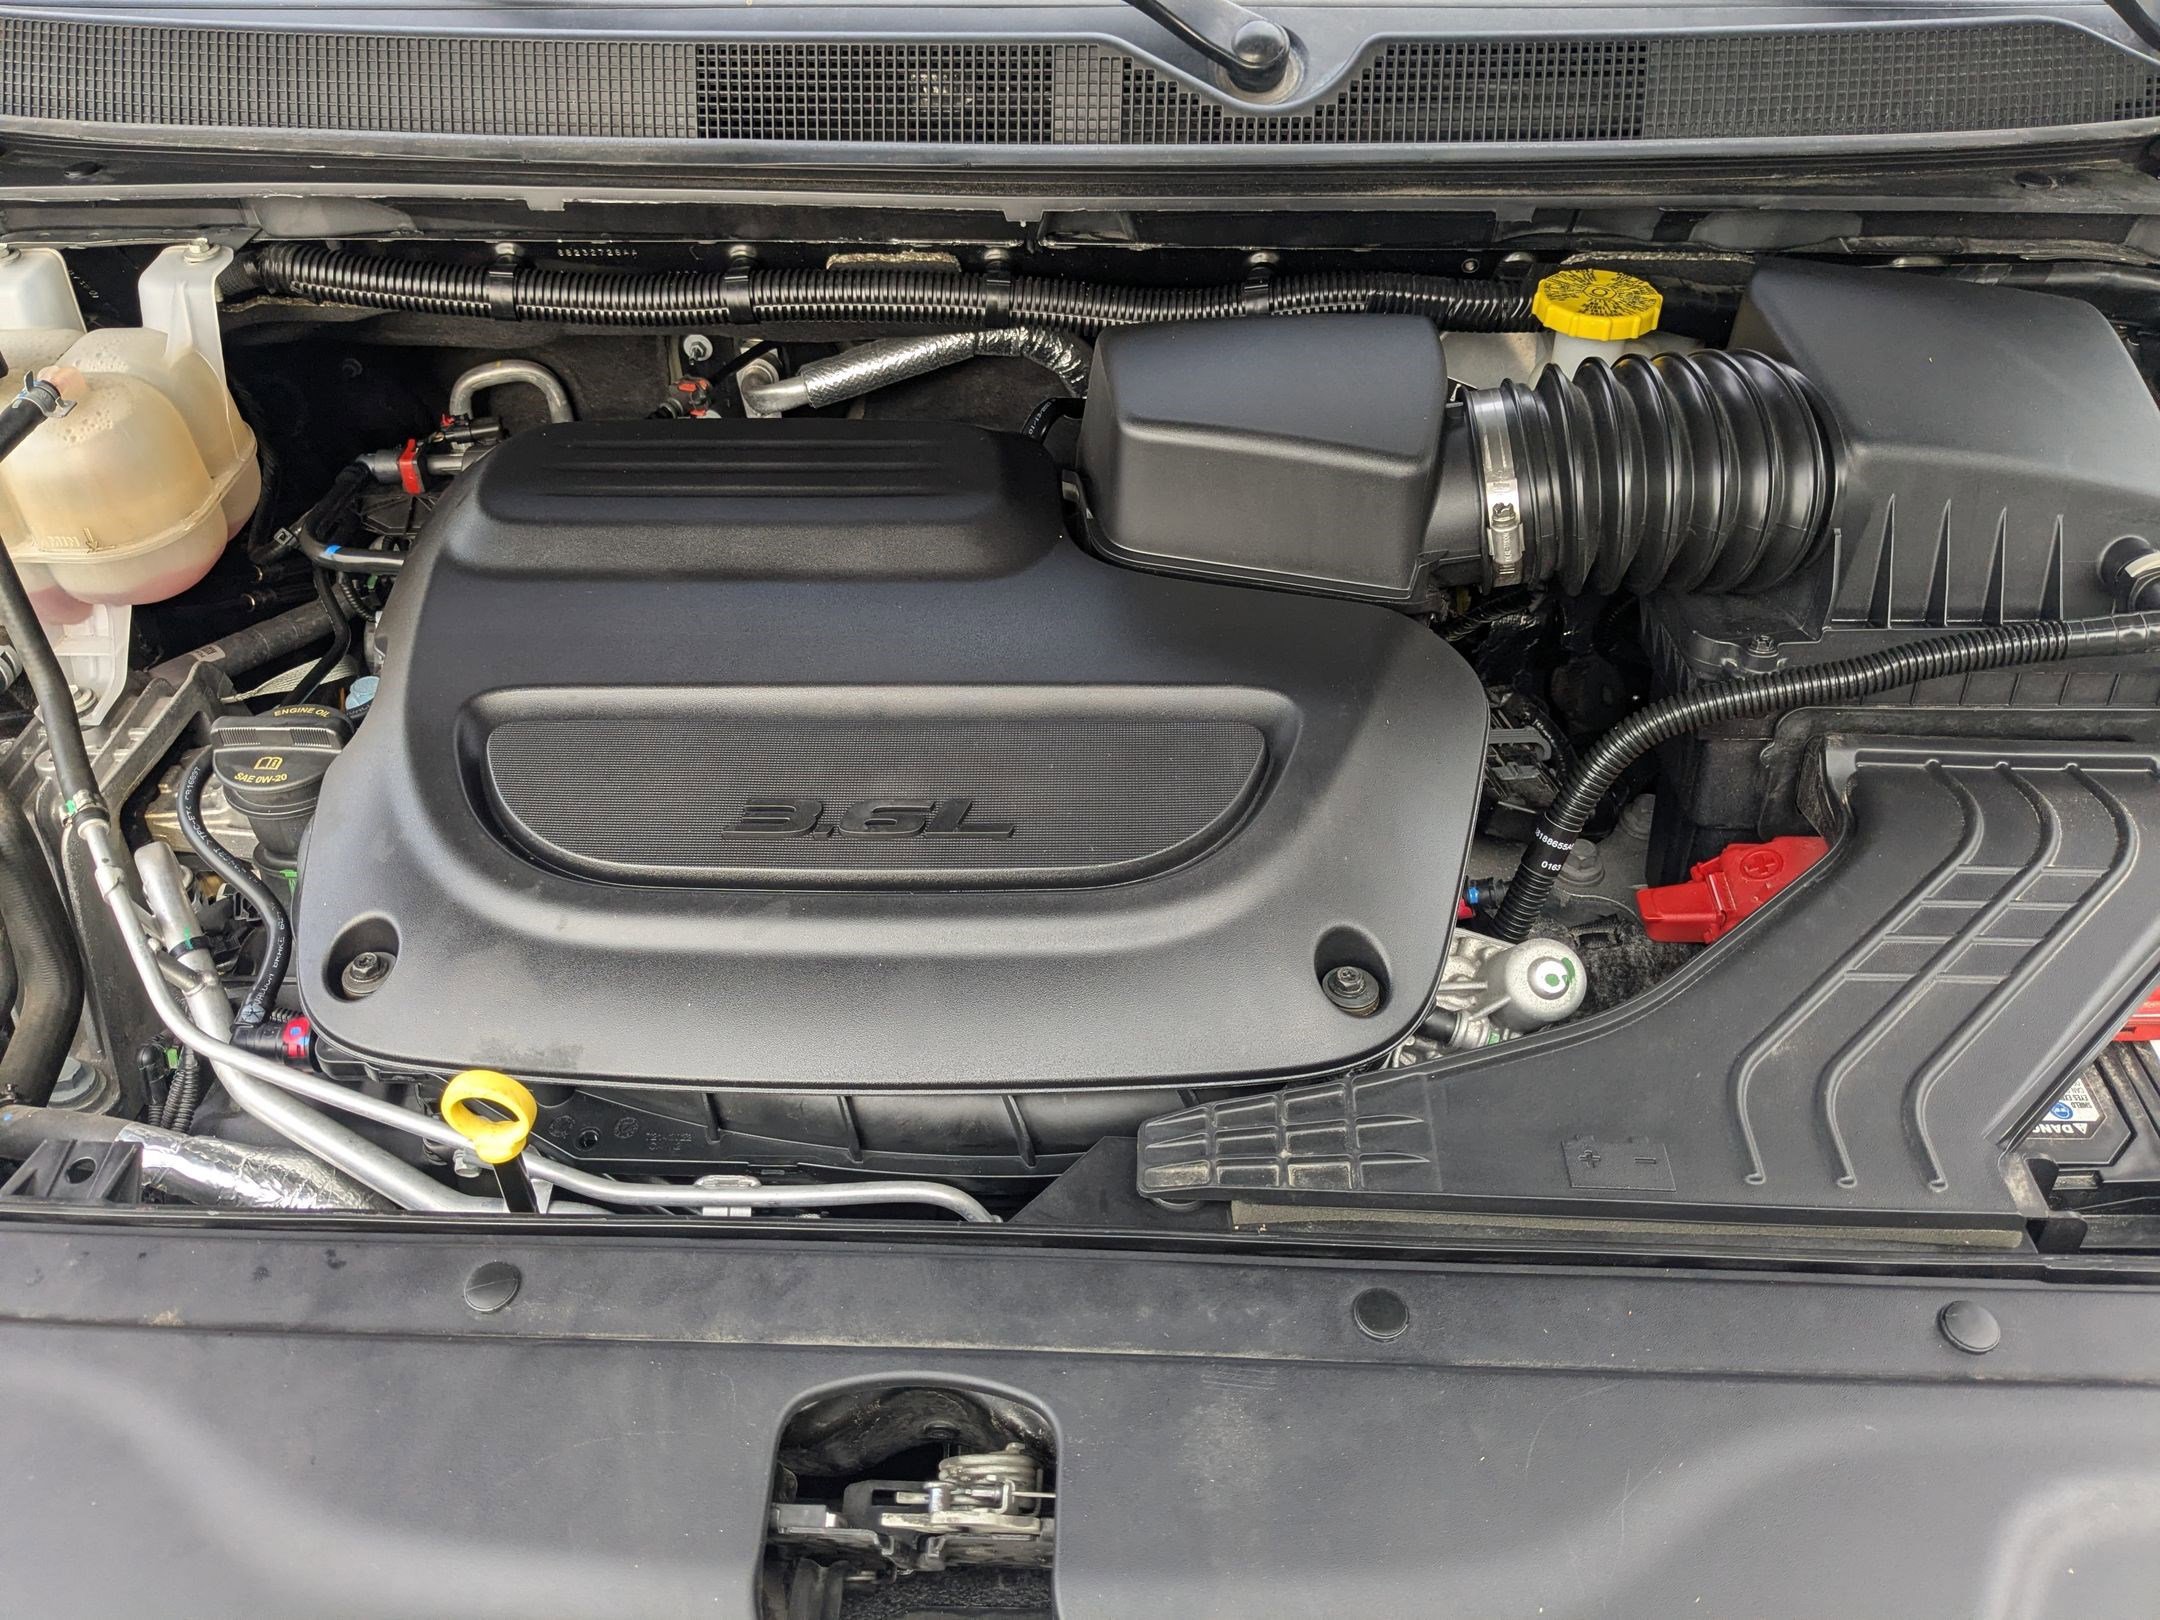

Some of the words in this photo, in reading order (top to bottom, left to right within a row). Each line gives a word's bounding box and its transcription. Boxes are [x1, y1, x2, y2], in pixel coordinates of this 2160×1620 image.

[273, 707, 315, 717] ENGINE
[315, 708, 331, 719] OIL
[234, 771, 254, 784] SAE
[255, 773, 288, 784] 0W-20
[721, 798, 1016, 840] 3.6L
